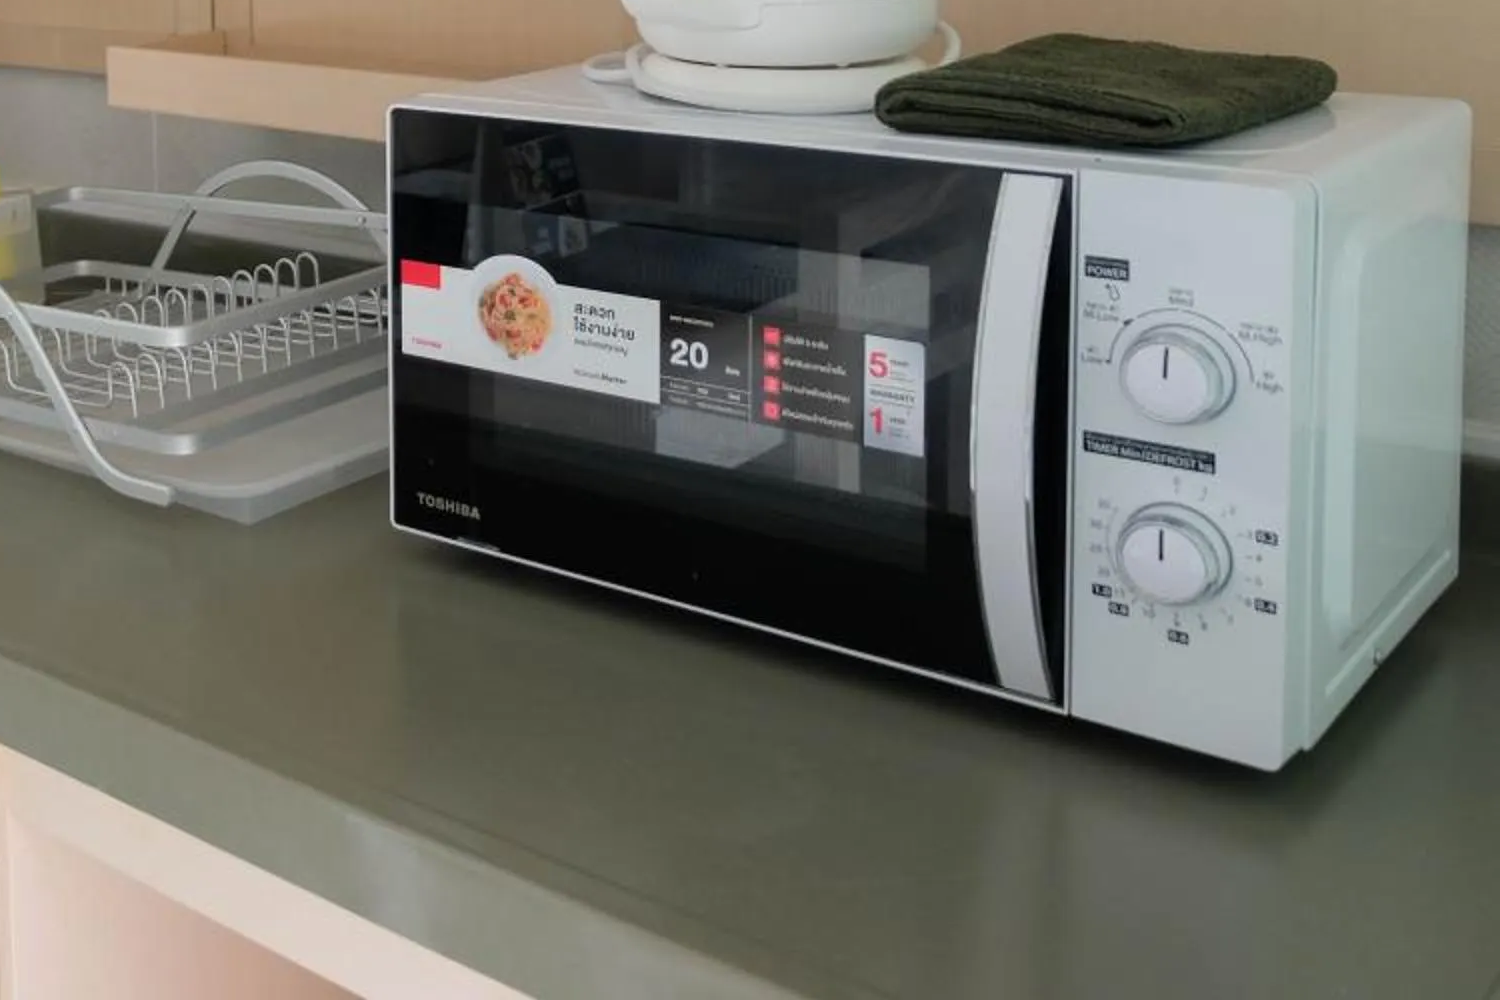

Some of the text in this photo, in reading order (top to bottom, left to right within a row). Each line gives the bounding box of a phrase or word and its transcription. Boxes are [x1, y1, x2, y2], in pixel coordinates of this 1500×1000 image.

[1086, 264, 1128, 280] POWER
[670, 337, 709, 370] 20
[868, 351, 888, 378] 5
[869, 406, 884, 435] 1
[416, 491, 481, 520] TOSHIBA
